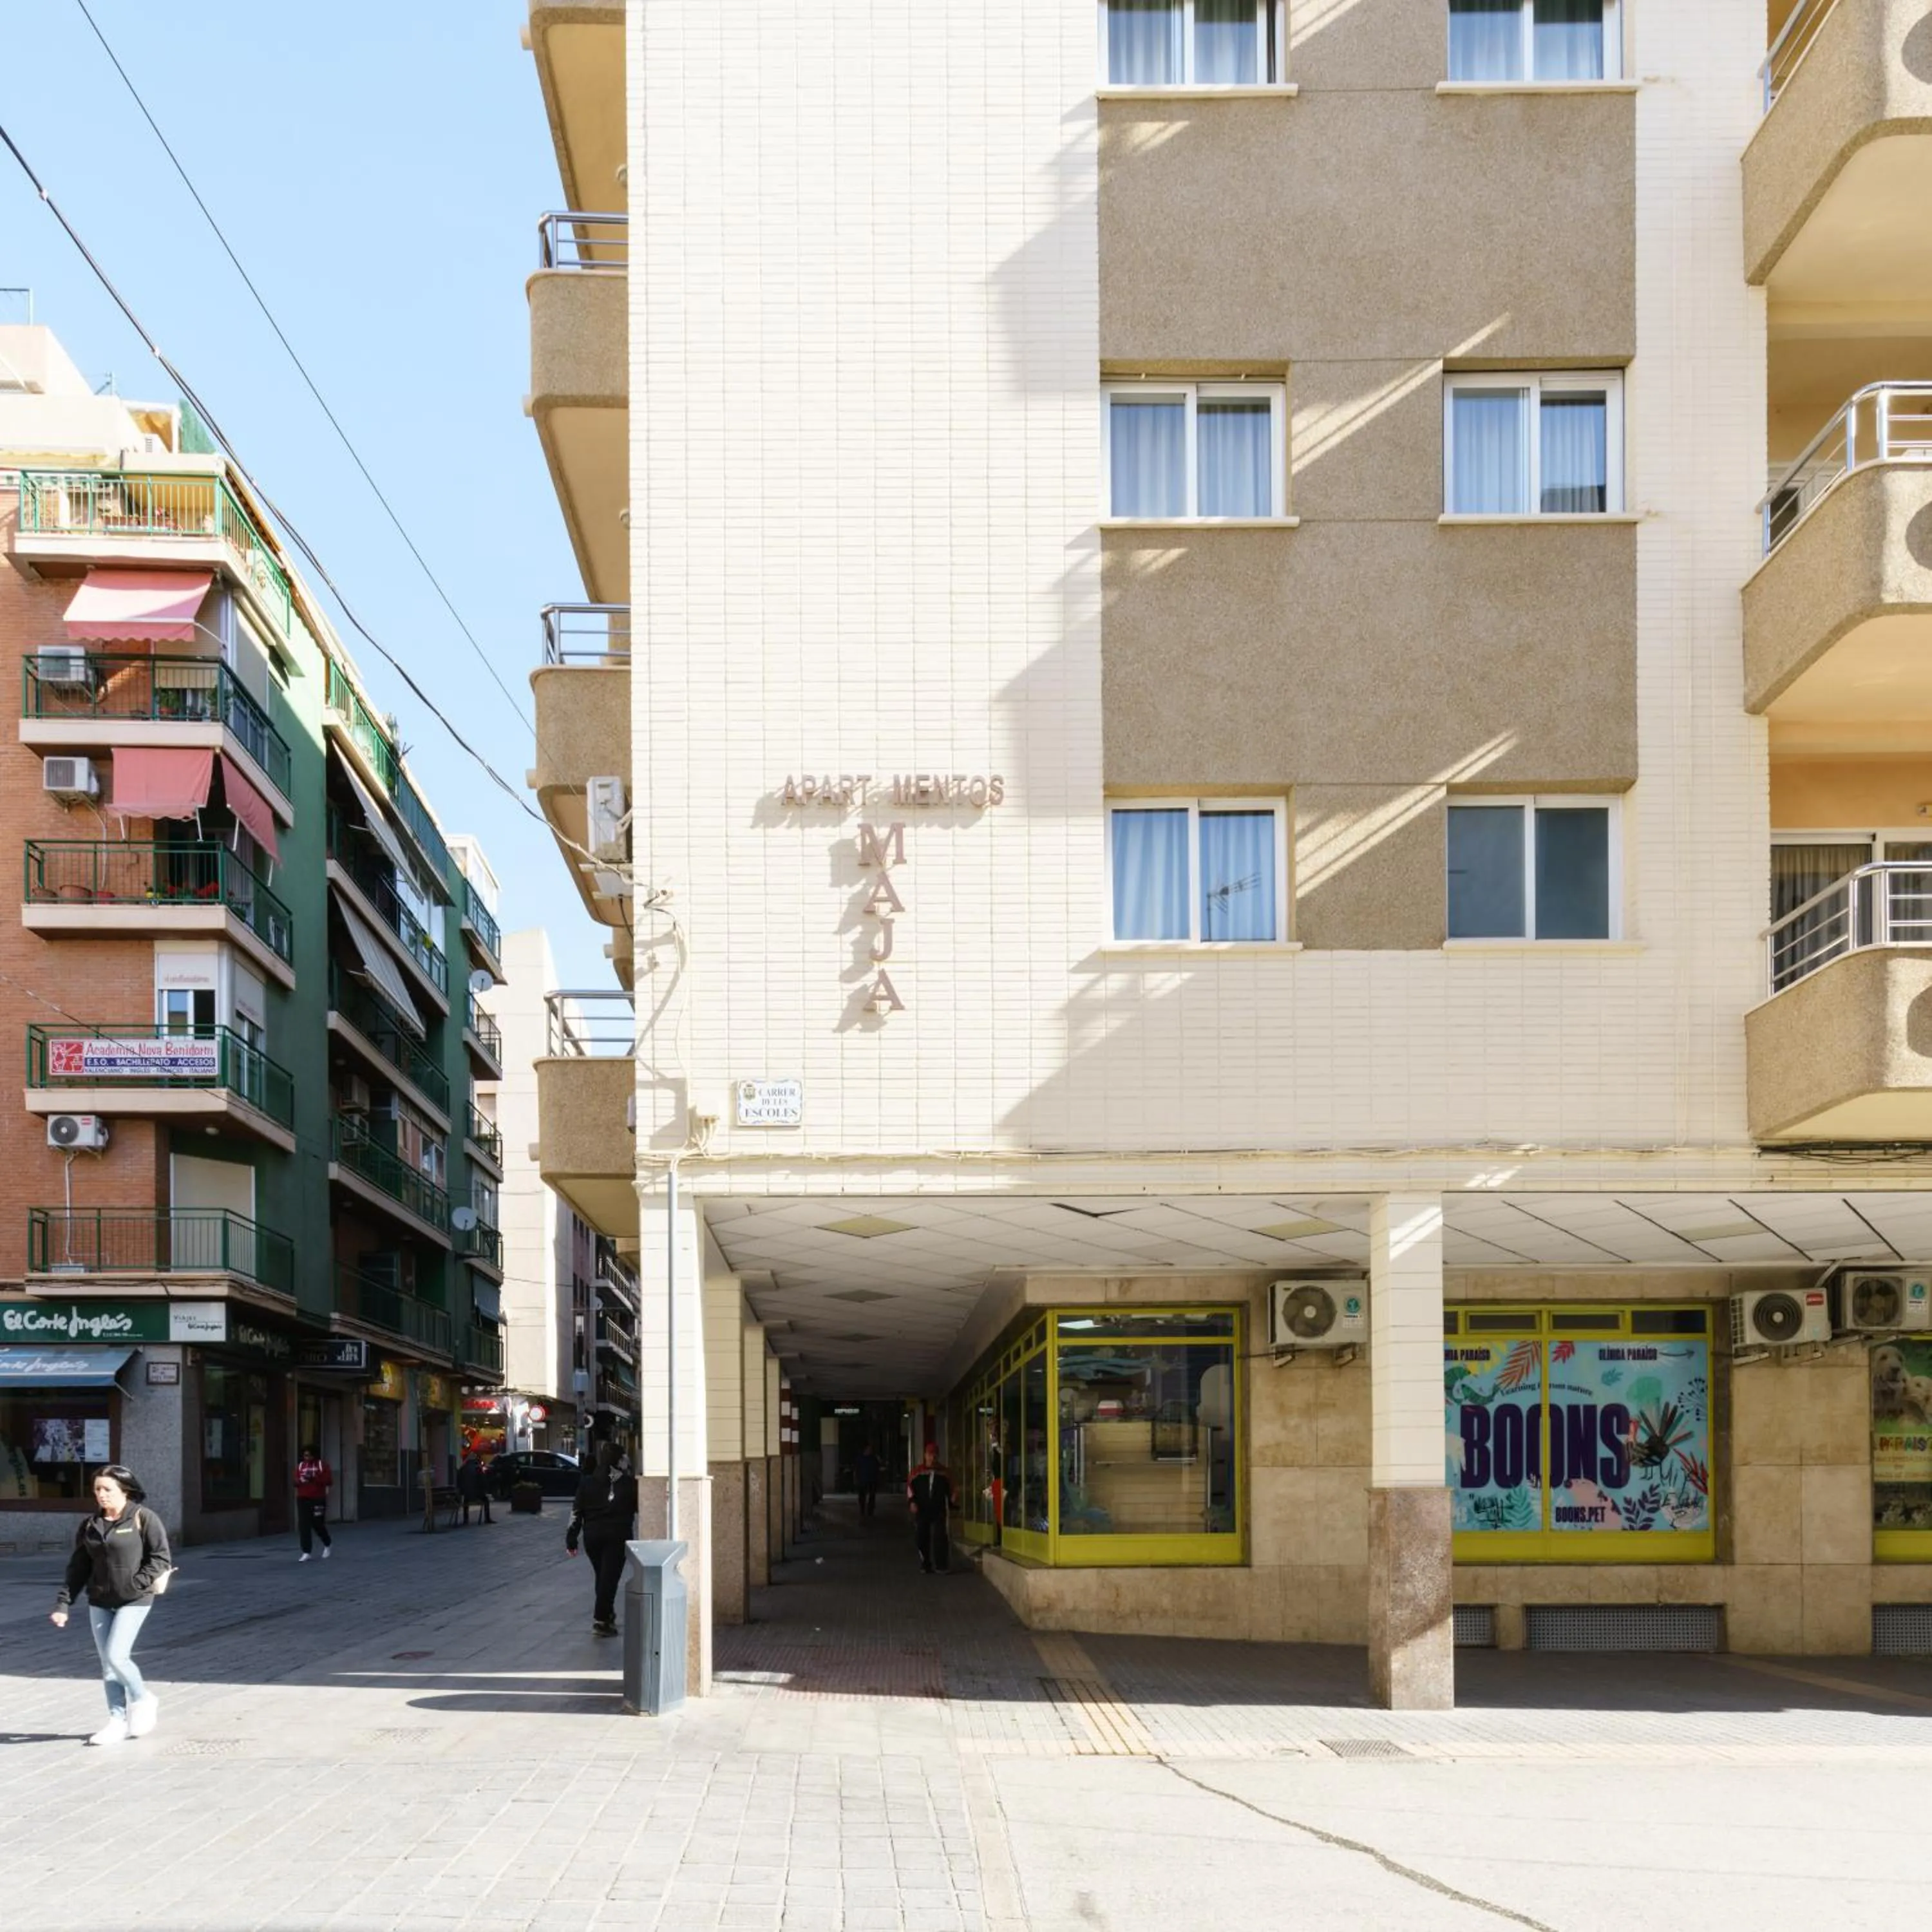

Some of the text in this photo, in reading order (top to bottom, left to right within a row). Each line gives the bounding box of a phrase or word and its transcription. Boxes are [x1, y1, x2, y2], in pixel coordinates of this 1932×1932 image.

[858, 822, 907, 1011] MAJA
[86, 1040, 214, 1056] Academia Nova Benidorm
[177, 1058, 214, 1066] ACCESOS
[758, 1087, 796, 1097] CARRER
[745, 1108, 798, 1118] ESCOLES
[3, 1305, 133, 1338] El Corte Inglés
[1460, 1403, 1631, 1489] BOONS
[1555, 1506, 1606, 1523] BOONS.PET
